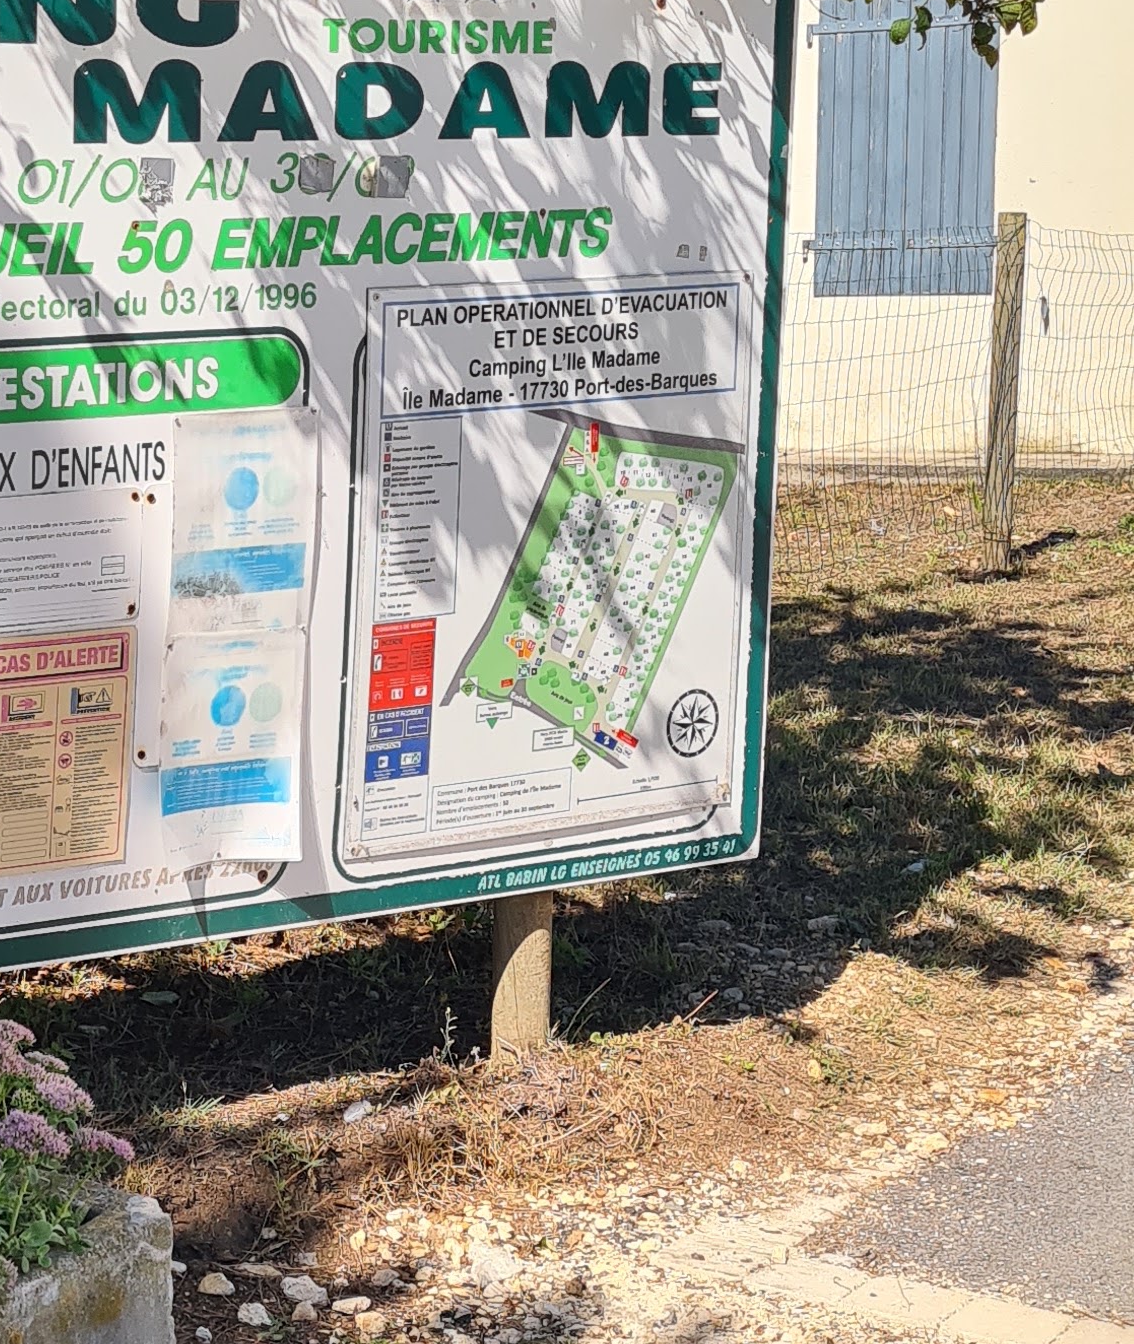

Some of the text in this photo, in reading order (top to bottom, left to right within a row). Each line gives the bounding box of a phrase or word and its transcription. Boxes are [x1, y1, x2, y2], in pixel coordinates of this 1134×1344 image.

[323, 17, 555, 55] TOURISME
[73, 58, 723, 145] MADAME
[18, 154, 177, 209] 01/0
[187, 157, 250, 202] AU
[117, 217, 194, 274] 50
[212, 206, 613, 271] EMPLACEMENTS
[115, 290, 147, 317] du
[160, 281, 318, 318] 03/12/1996
[397, 290, 728, 327] PLAN OPERATIONNEL D'EVACUATION
[494, 322, 639, 348] ET DE SECOURS
[469, 356, 547, 379] Camping
[592, 349, 661, 369] Madame
[402, 387, 423, 410] Île
[429, 387, 503, 408] Madame
[520, 380, 569, 401] 17730
[574, 373, 718, 397] Port-des-Barques
[30, 440, 166, 491] D'ENFANTS
[36, 644, 119, 671] D'ALERTE
[477, 873, 502, 892] ATL
[506, 866, 547, 886] BABIN
[570, 854, 641, 878] ENSEIGNES
[644, 851, 661, 866] 05
[703, 842, 718, 857] 35
[12, 882, 55, 906] AUX
[59, 867, 153, 899] VOITURES
